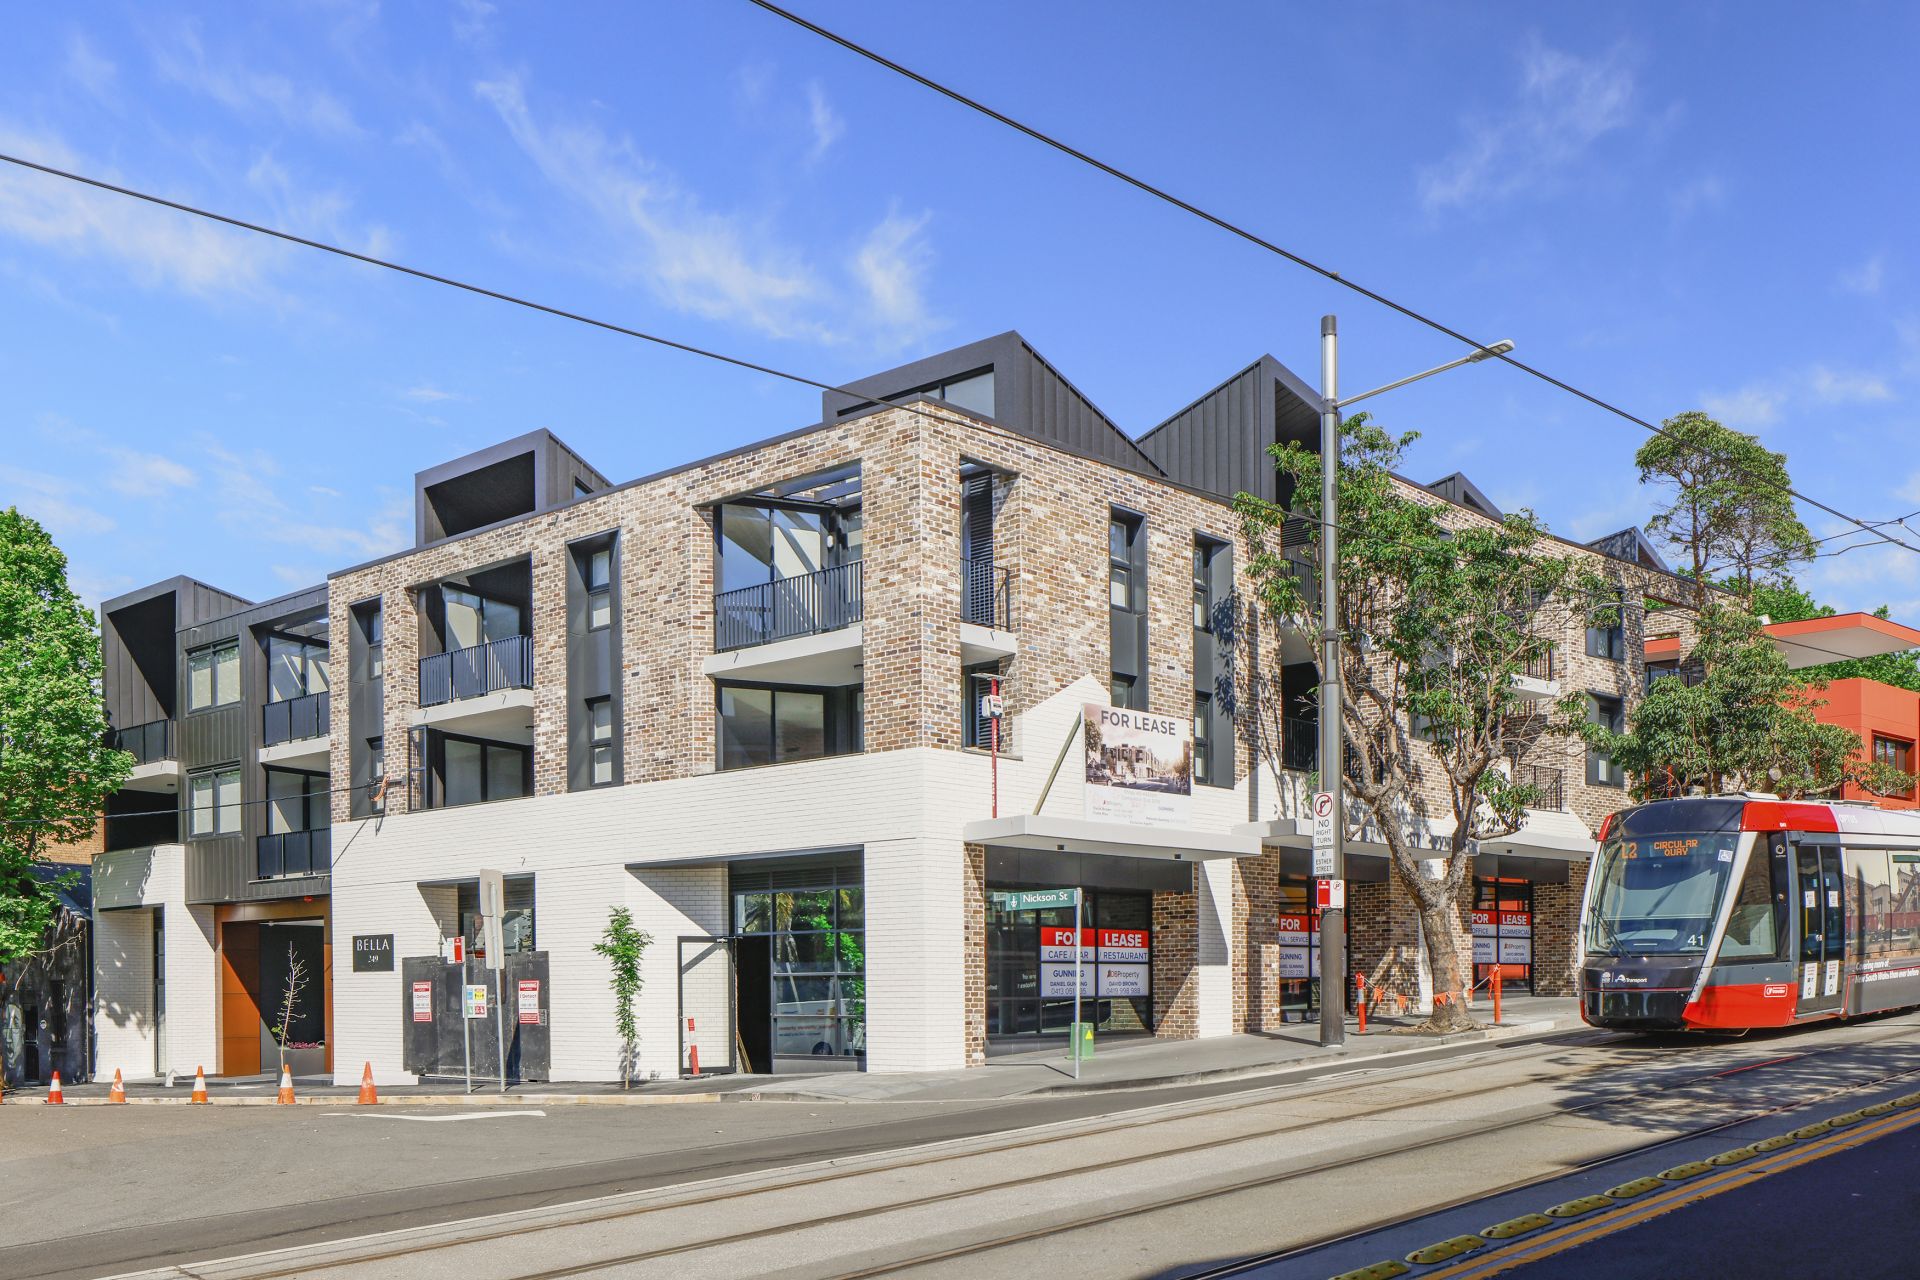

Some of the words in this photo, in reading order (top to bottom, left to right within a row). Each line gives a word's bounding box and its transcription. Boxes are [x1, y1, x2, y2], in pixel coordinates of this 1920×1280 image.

[1100, 709, 1130, 729] FOR
[1134, 715, 1176, 736] LEASE
[1318, 819, 1330, 828] NO
[1316, 836, 1332, 844] TURN
[1653, 839, 1698, 850] CIRCULAR
[1621, 842, 1638, 859] L2
[1664, 847, 1689, 857] QUAY
[1315, 858, 1332, 866] ESTHER
[1315, 865, 1332, 873] STREET
[1022, 893, 1057, 903] Nickson
[1059, 891, 1068, 900] St
[1280, 918, 1300, 931] FOR
[1472, 913, 1489, 924] FOR
[1502, 914, 1527, 925] LEASE
[1501, 928, 1530, 936] COMMERCIAL
[356, 938, 390, 951] BELLA
[1104, 933, 1142, 947] LEASE
[1687, 934, 1704, 946] 41
[1048, 950, 1068, 959] CAFE
[1103, 951, 1147, 960] RESTAURANT
[1053, 969, 1085, 978] GUNNIG
